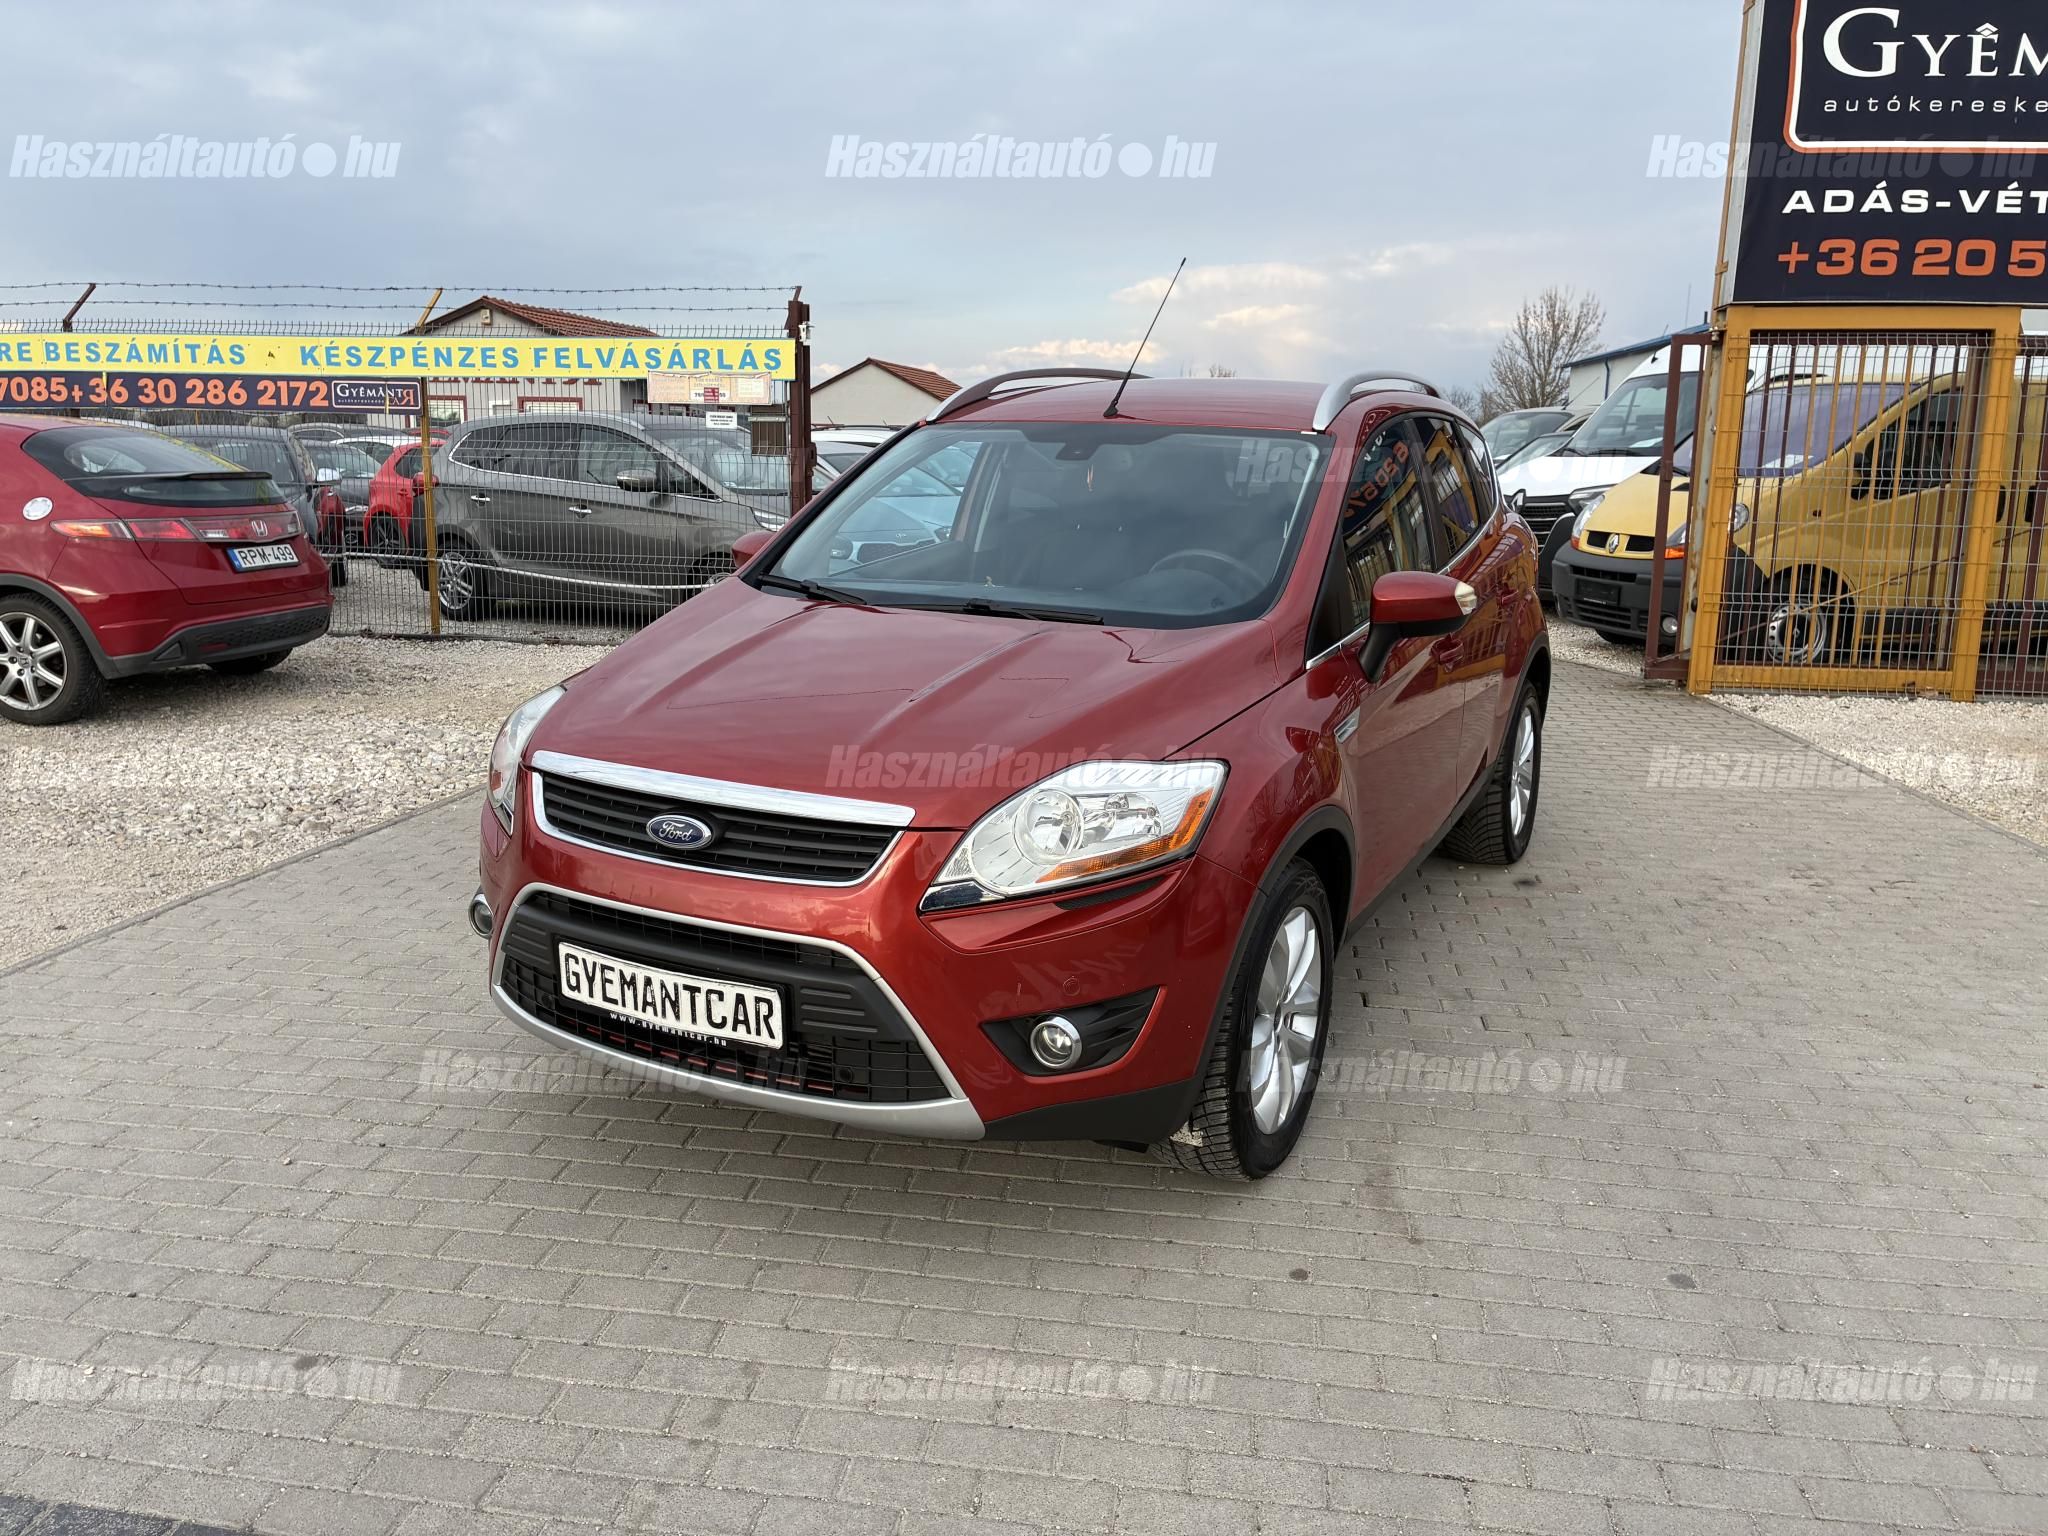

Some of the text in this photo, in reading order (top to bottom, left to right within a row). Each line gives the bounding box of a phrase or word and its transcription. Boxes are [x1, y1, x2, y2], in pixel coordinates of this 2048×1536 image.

[1778, 239, 2047, 277] +36 20 5
[44, 338, 246, 365] BESZÁMÍTÁS
[300, 340, 782, 370] KÉSZPÉNZES FELVÁSÁRLÁS
[138, 378, 177, 404] 30
[185, 379, 248, 405] 286
[257, 379, 330, 407] 2172
[238, 546, 295, 565] RPM-499
[659, 820, 693, 841] Ford
[564, 952, 776, 1039] GYEMANTCAR
